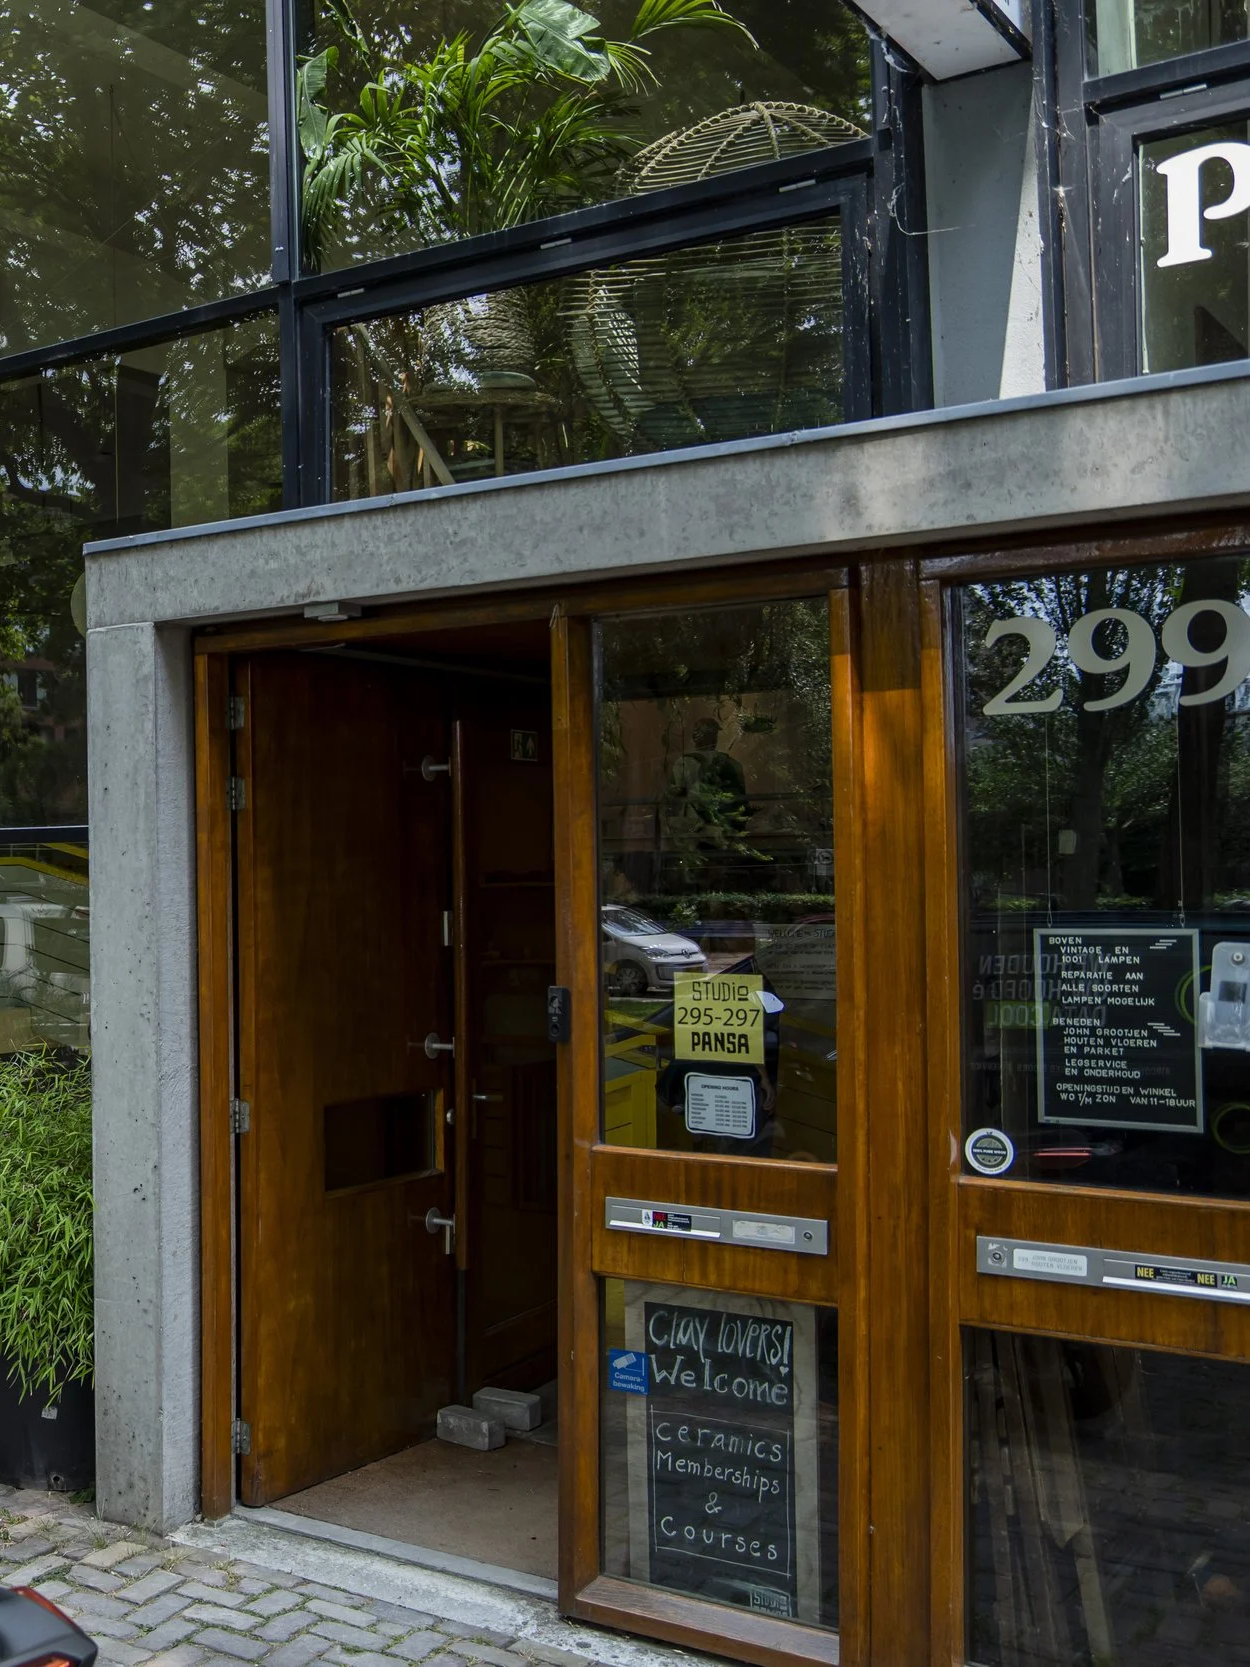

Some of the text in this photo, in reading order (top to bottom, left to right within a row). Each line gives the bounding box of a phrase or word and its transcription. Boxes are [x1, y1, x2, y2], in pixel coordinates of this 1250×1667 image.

[983, 599, 1250, 716] 299
[1049, 936, 1082, 945] BOVEN
[1060, 946, 1129, 954] VINTAGE EN
[1062, 956, 1140, 964] 1001 LAMPEN
[1061, 971, 1144, 981] REPARATIE AAN
[1061, 983, 1139, 993] ALLE SOORTEN
[1062, 996, 1155, 1006] LAMPEN MOGELIJK
[677, 1007, 760, 1027] 295-297
[1053, 1018, 1100, 1026] BENEDEN
[1063, 1028, 1148, 1037] JOHN GROOTJEN
[691, 1031, 750, 1054] PANSA
[1064, 1037, 1157, 1047] HOUTEN VLOEREN
[1064, 1046, 1124, 1056] EN PARKET
[1065, 1058, 1127, 1069] LEGSERVICE
[1065, 1068, 1078, 1076] EN
[1084, 1069, 1141, 1079] ONDERHOUD
[1139, 1087, 1177, 1097] WINKEL
[1060, 1092, 1075, 1101] WO
[1096, 1094, 1116, 1103] ZON
[1130, 1096, 1147, 1105] VAN
[653, 1220, 664, 1228] JA
[1136, 1266, 1154, 1278] NEE
[1197, 1273, 1215, 1285] NEE
[1222, 1275, 1236, 1285] JA
[614, 1372, 644, 1383] Camera-
[649, 1353, 789, 1405] Welcome
[612, 1380, 645, 1392] bewaking
[656, 1422, 782, 1462] Ceramics
[656, 1450, 780, 1503] Memberships
[705, 1492, 722, 1514] &
[660, 1516, 778, 1560] Courses
